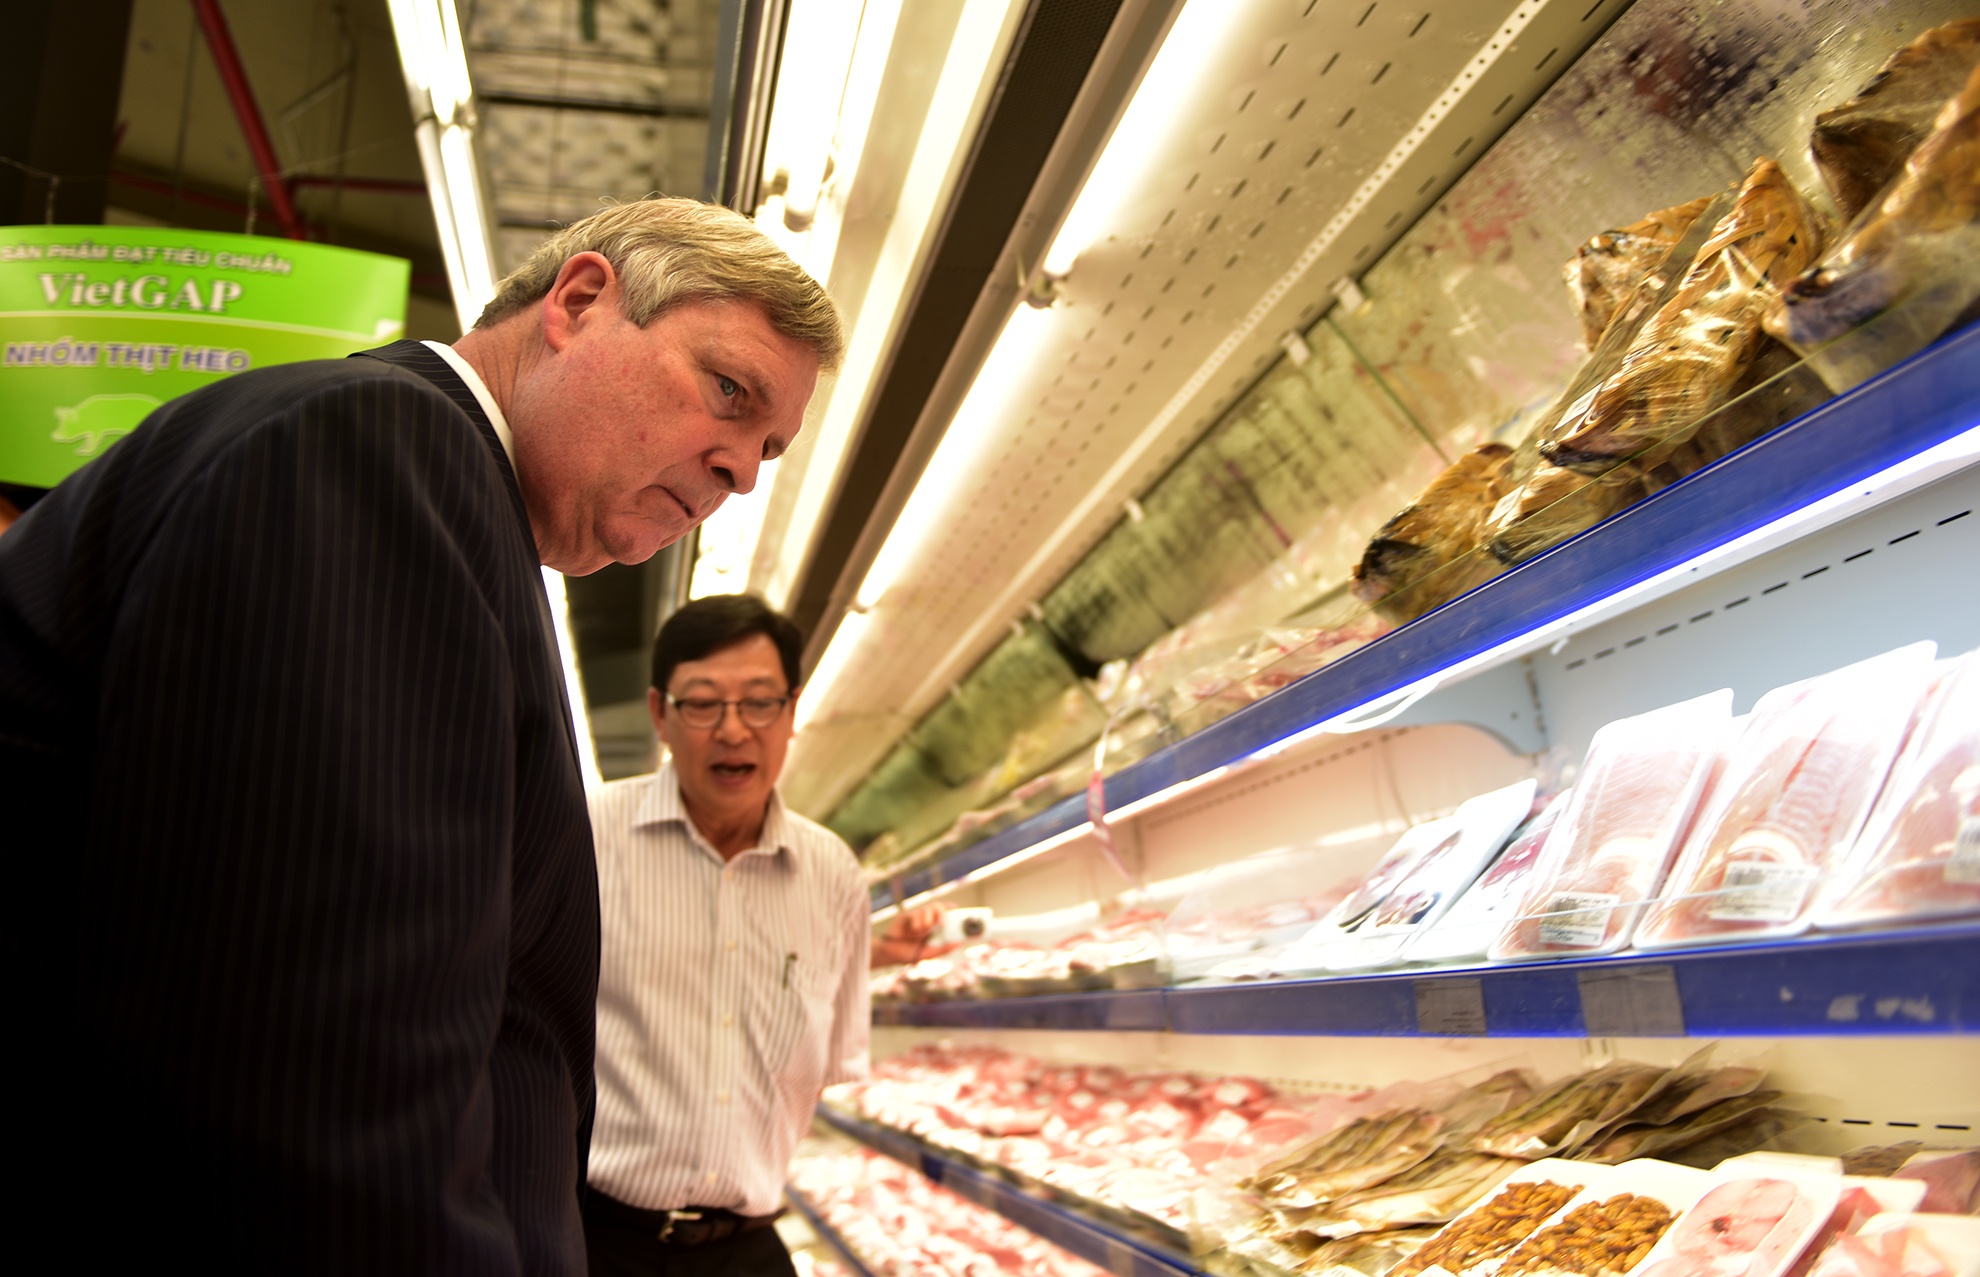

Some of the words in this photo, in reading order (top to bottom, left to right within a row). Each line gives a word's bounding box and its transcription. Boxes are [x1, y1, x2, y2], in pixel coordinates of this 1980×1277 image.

[38, 272, 242, 313] VietGAP
[4, 337, 99, 367] NHÓM
[105, 343, 178, 373] THỊT
[181, 346, 249, 373] HEO
